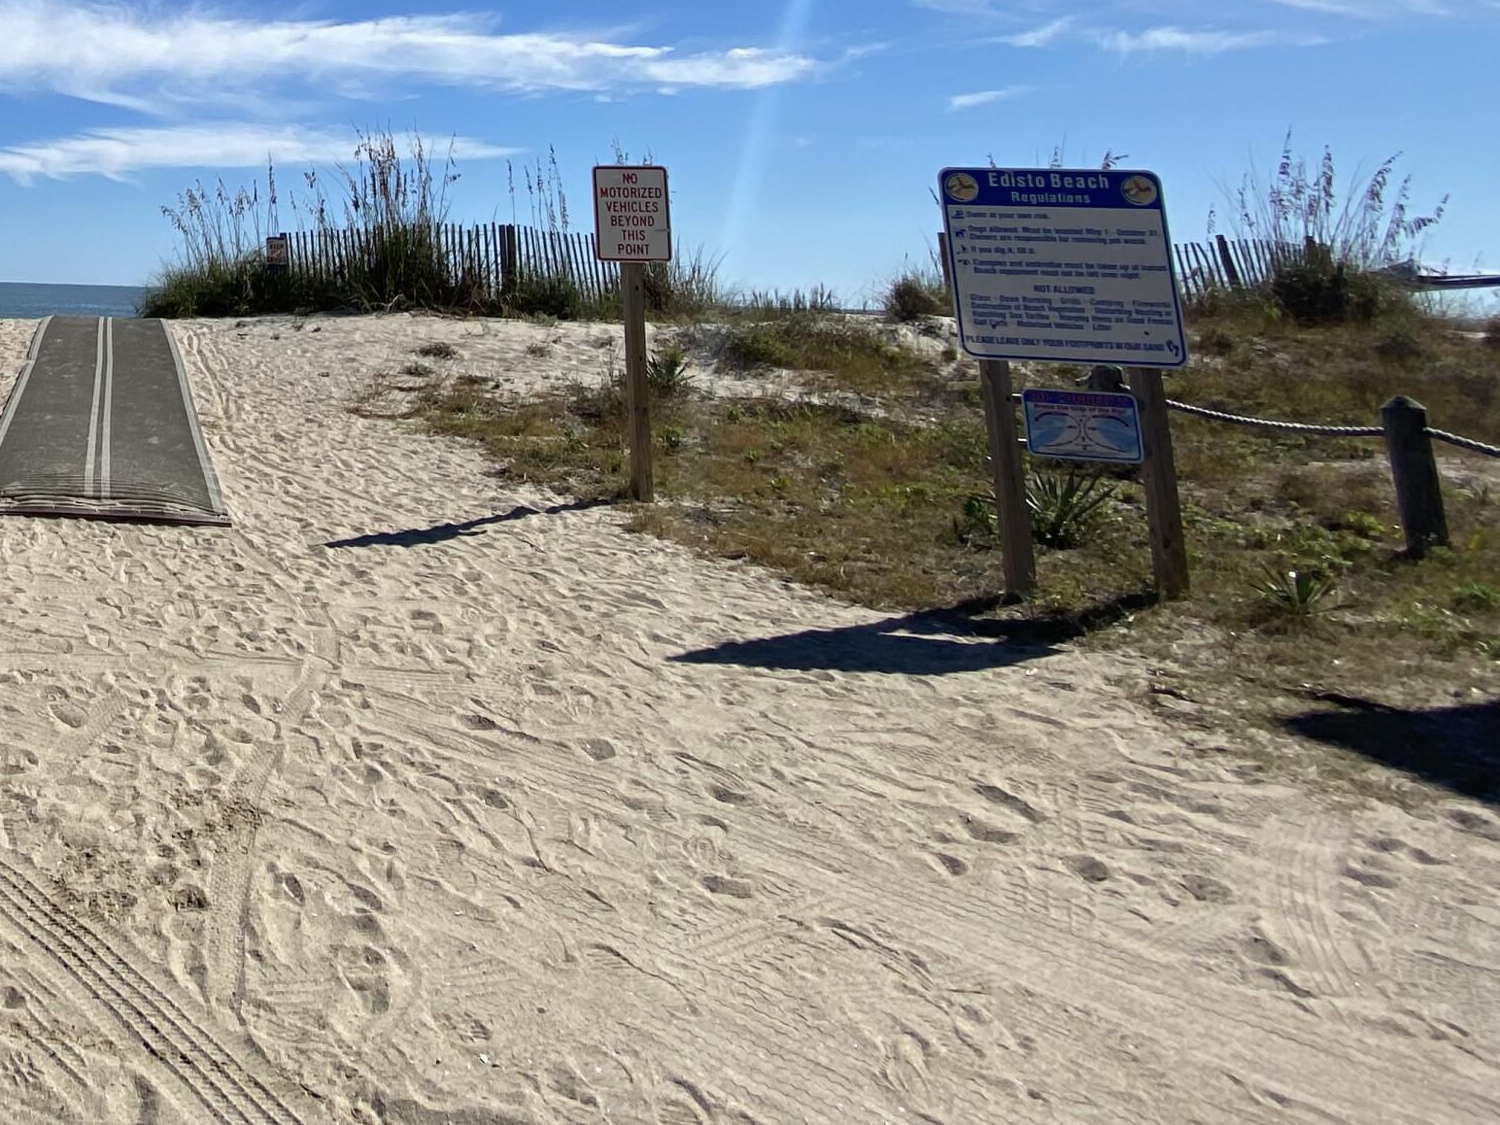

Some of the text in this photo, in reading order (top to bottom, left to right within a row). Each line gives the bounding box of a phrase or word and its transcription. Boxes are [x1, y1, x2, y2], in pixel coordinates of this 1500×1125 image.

[623, 173, 638, 184] NO
[988, 173, 1109, 189] Edisto Beach
[600, 187, 662, 199] MOTORIZED
[1011, 191, 1091, 205] Regulations
[606, 201, 659, 213] VEHICLES
[611, 215, 655, 227] BEYOND
[621, 229, 647, 242] THIS
[617, 244, 651, 256] POINT
[1034, 284, 1052, 293] NOT
[965, 335, 996, 344] PLEASE
